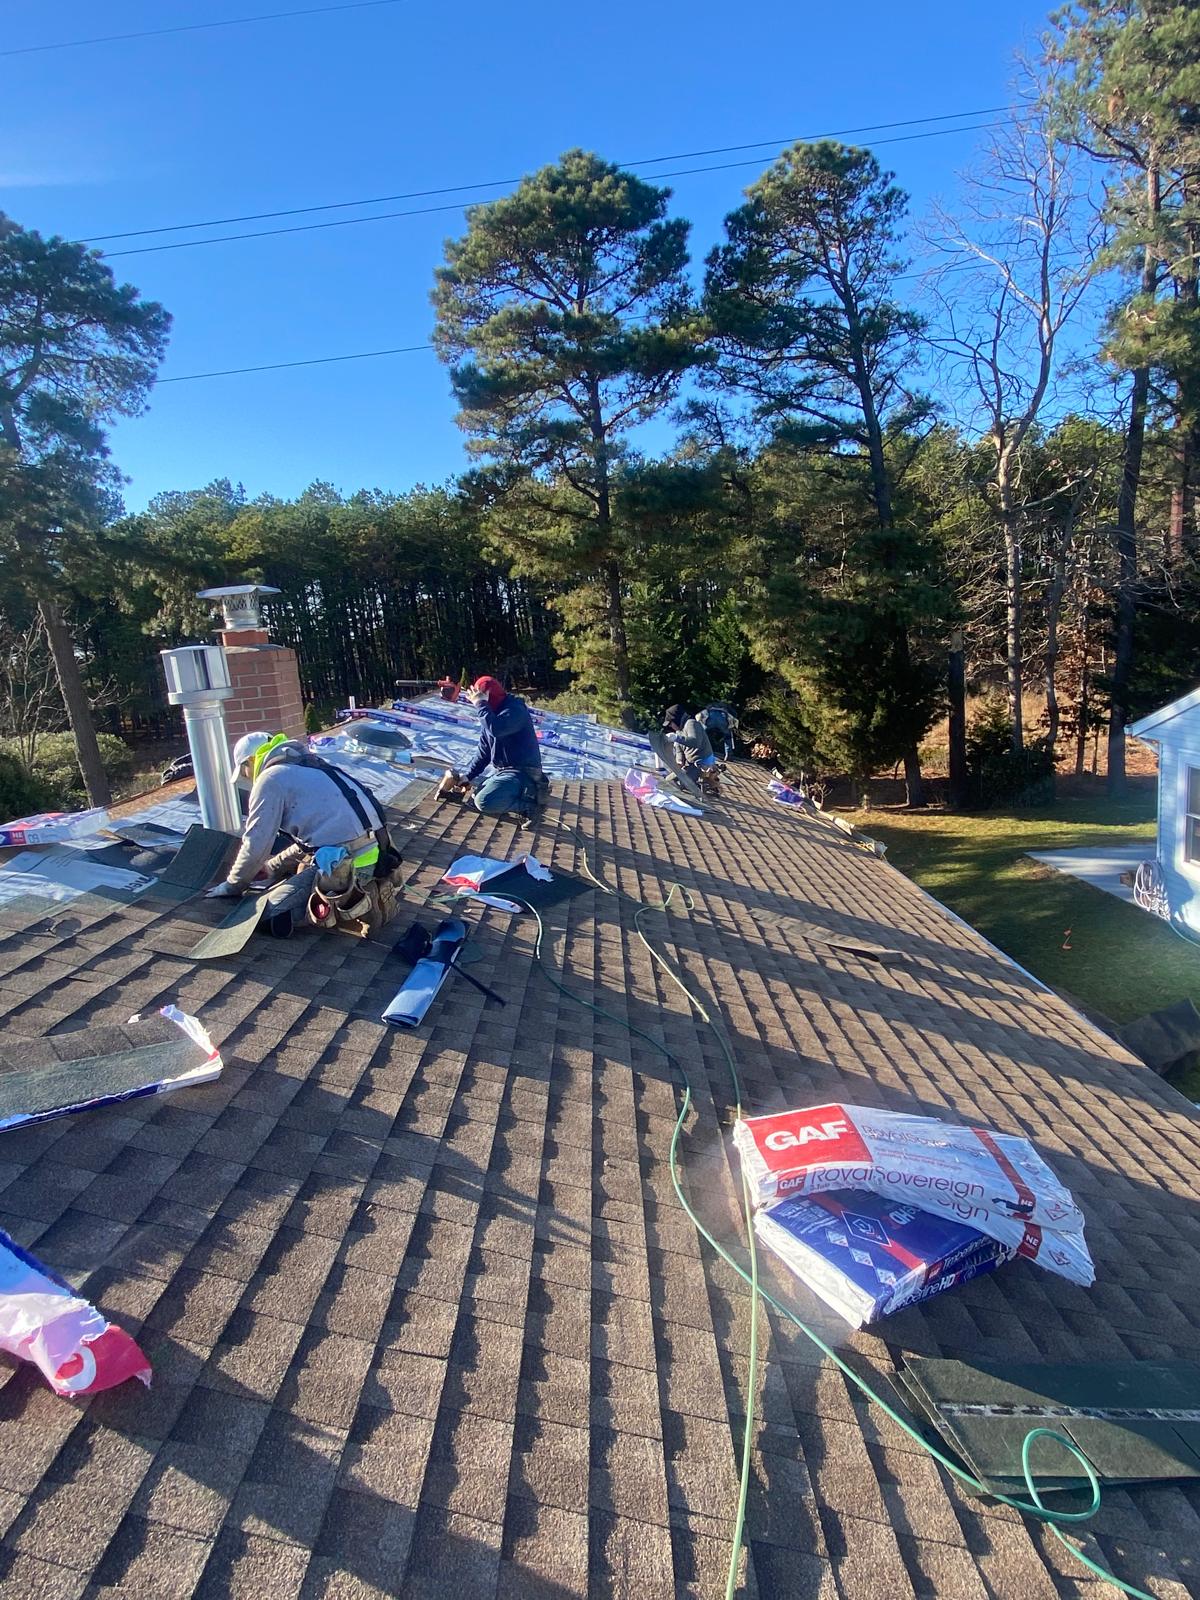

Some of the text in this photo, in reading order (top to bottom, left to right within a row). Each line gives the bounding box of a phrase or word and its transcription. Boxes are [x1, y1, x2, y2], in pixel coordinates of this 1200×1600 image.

[764, 1119, 848, 1151] GAF
[780, 1166, 985, 1198] GAF RoyalSovereign
[1025, 1233, 1040, 1247] NE
